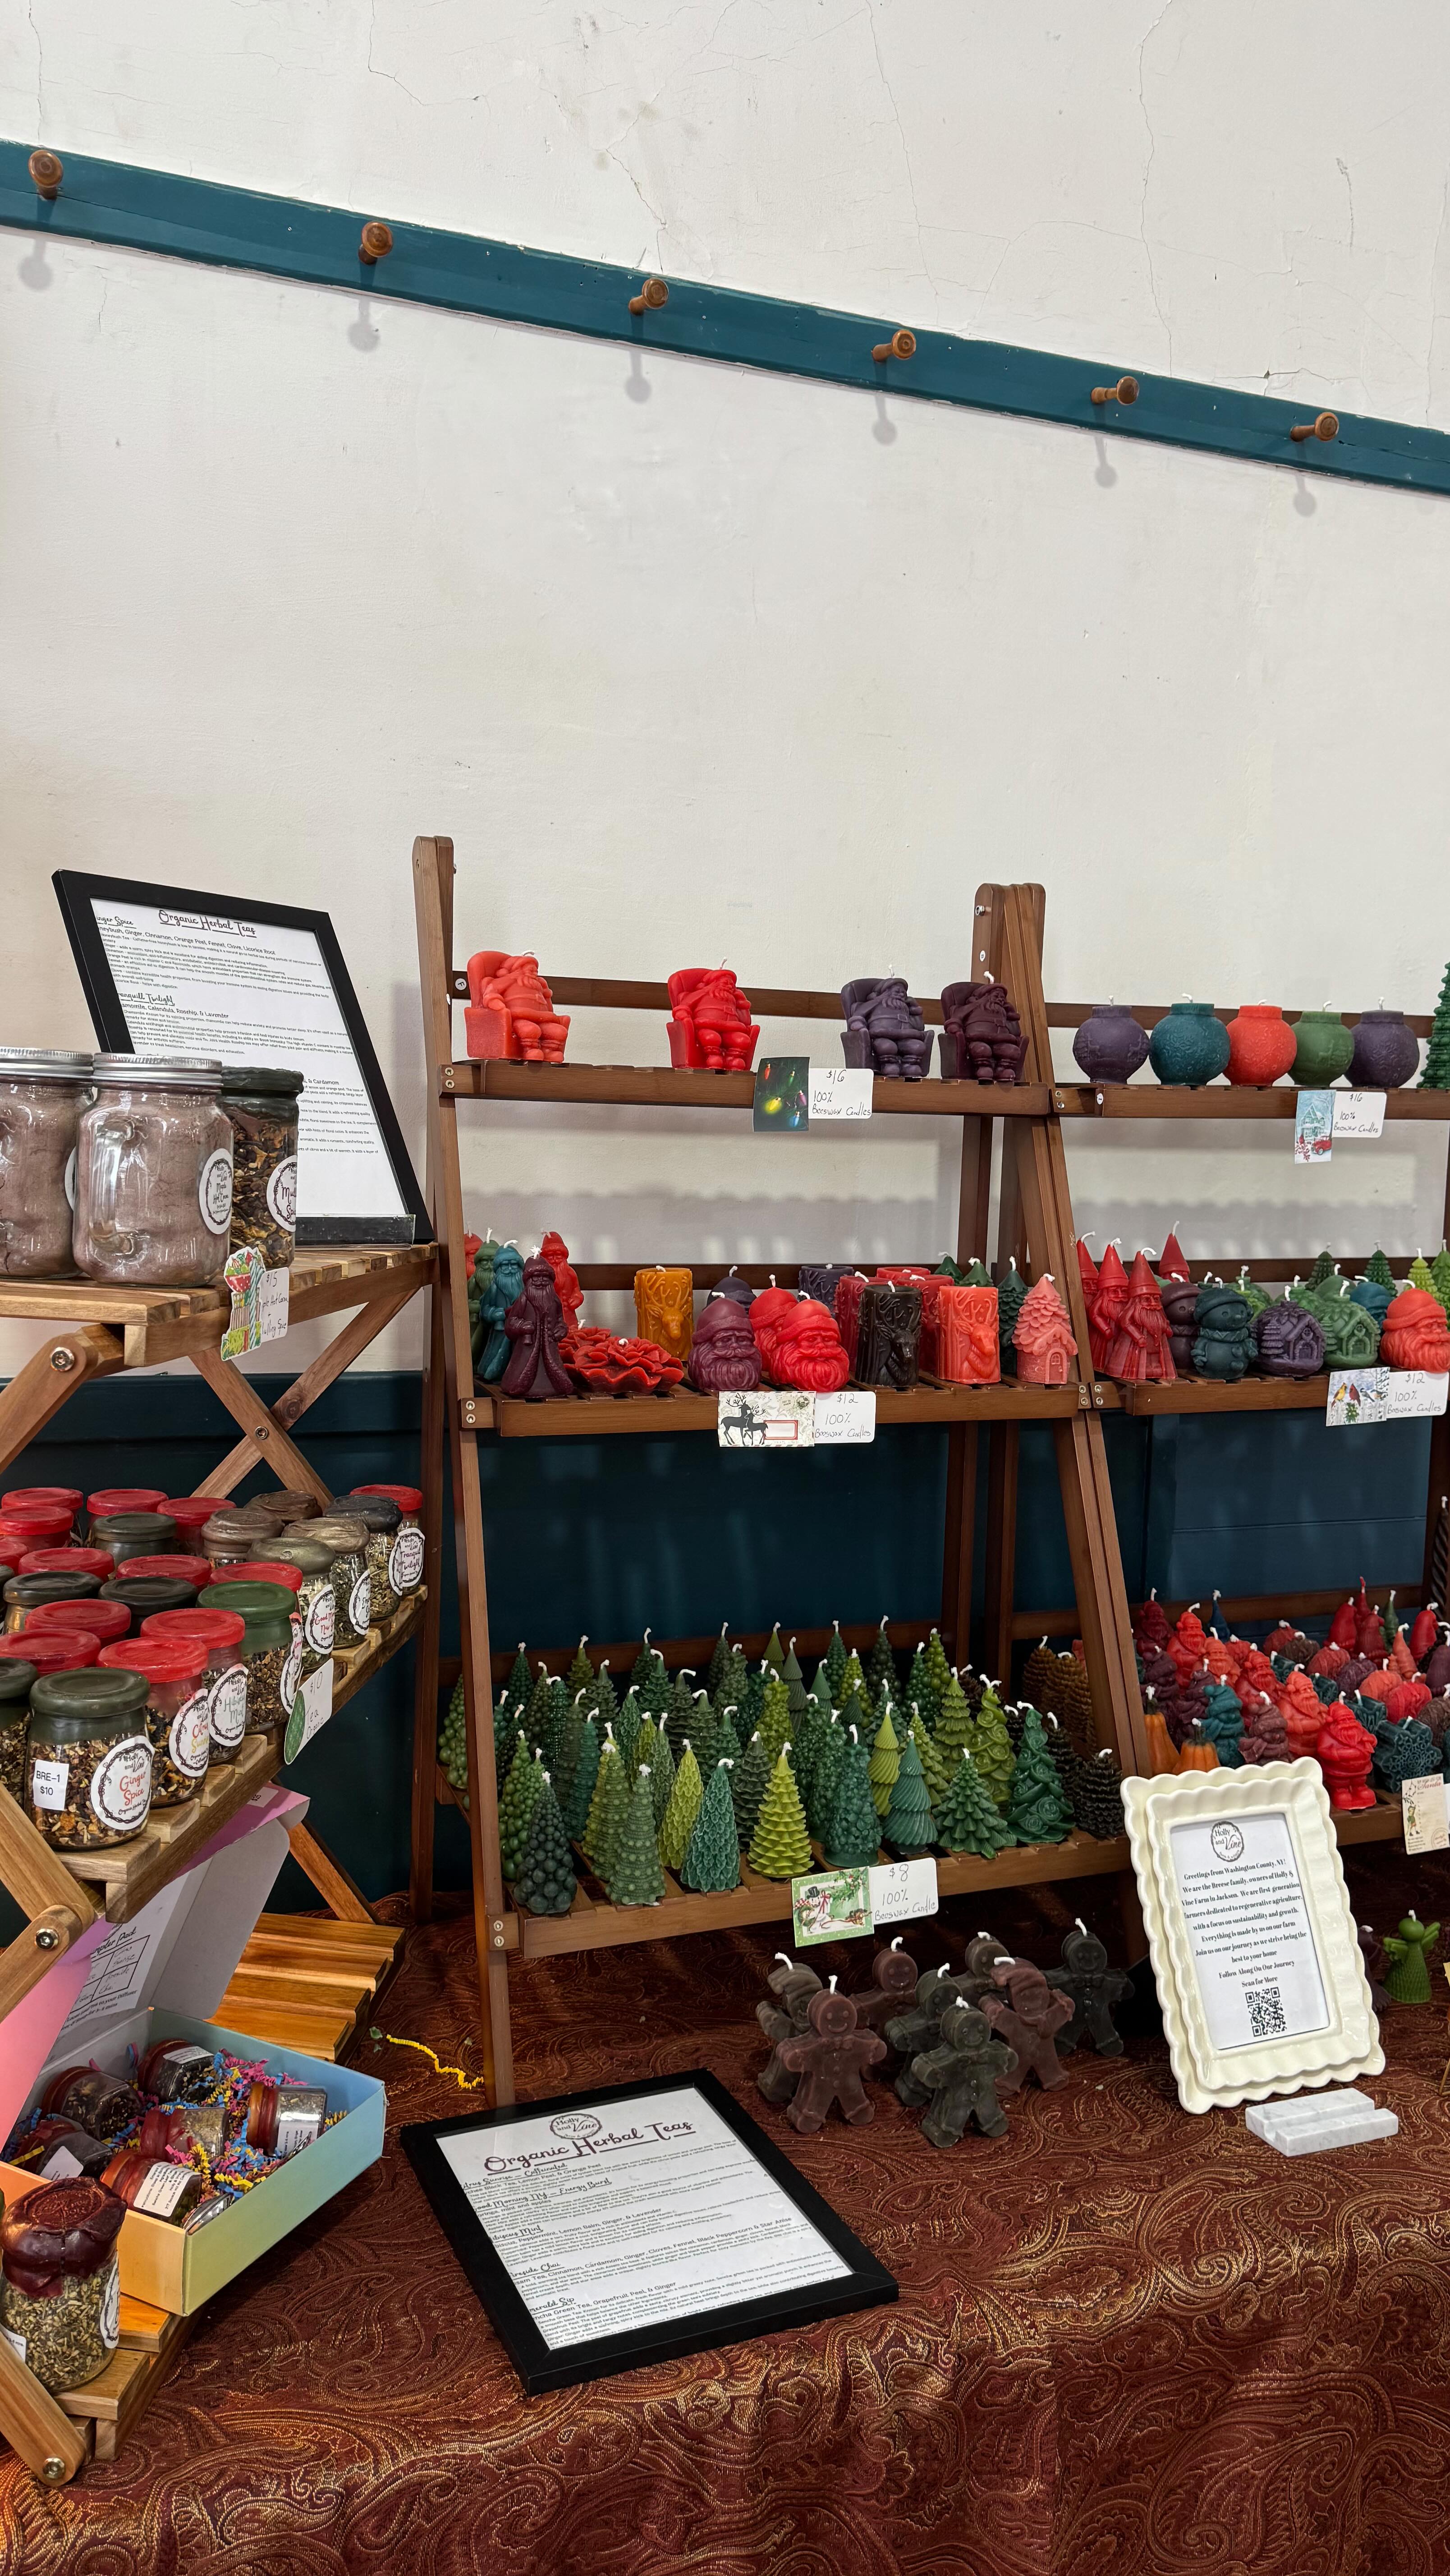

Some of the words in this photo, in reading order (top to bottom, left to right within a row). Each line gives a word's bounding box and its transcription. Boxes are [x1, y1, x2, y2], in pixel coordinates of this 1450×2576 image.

[159, 910, 199, 926] Organic
[200, 916, 234, 931] Herbal
[234, 921, 256, 937] Teas
[826, 1069, 846, 1084] $16
[814, 1090, 833, 1103] 100%
[1349, 1093, 1363, 1102] $16
[812, 1104, 842, 1115] Beeswax
[846, 1102, 871, 1116] Candles
[1340, 1111, 1355, 1120] 100%
[1358, 1122, 1379, 1133] Candles
[266, 1271, 277, 1288] $15
[1405, 1372, 1425, 1384] $12
[837, 1393, 858, 1404] $12
[1395, 1390, 1417, 1402] 100%
[1417, 1400, 1441, 1412] Candles
[825, 1412, 851, 1426] 100%
[815, 1429, 843, 1438] Beeswax
[847, 1424, 871, 1439] Candles
[310, 1671, 323, 1695] $10
[305, 1705, 318, 1725] Tea
[36, 1771, 60, 1783] BRE-1
[119, 1771, 146, 1792] Ginger
[40, 1785, 54, 1796] $10
[124, 1788, 145, 1806] Spice
[1215, 1828, 1230, 1837] Holly
[1225, 1834, 1241, 1849] Vine
[1184, 1872, 1210, 1880] Greetings
[1224, 1865, 1256, 1873] Washington
[1230, 1877, 1249, 1886] family,
[882, 1889, 909, 1906] 100%
[1216, 1893, 1239, 1901] Jackson.
[1272, 1882, 1300, 1893] generation
[875, 1908, 909, 1921] Beeswax
[912, 1895, 936, 1913] Candle
[1206, 1905, 1232, 1915] dedicated
[1239, 1899, 1271, 1911] regenerative
[1272, 1895, 1303, 1905] agriculture.
[1193, 1923, 1206, 1931] with
[1232, 1913, 1267, 1923] sustainability
[1268, 1909, 1278, 1918] and
[1201, 1932, 1232, 1942] Everything
[1237, 1928, 1251, 1936] made
[1232, 1942, 1253, 1952] journey
[1249, 1953, 1262, 1962] your
[1219, 1970, 1237, 1979] Follow
[1274, 1960, 1294, 1969] Journey
[573, 2120, 597, 2132] Vine
[484, 2146, 569, 2172] Organic
[572, 2127, 644, 2156] Herbal
[644, 2121, 693, 2140] Teas
[553, 2307, 575, 2315] Green
[654, 2282, 676, 2291] Ginger
